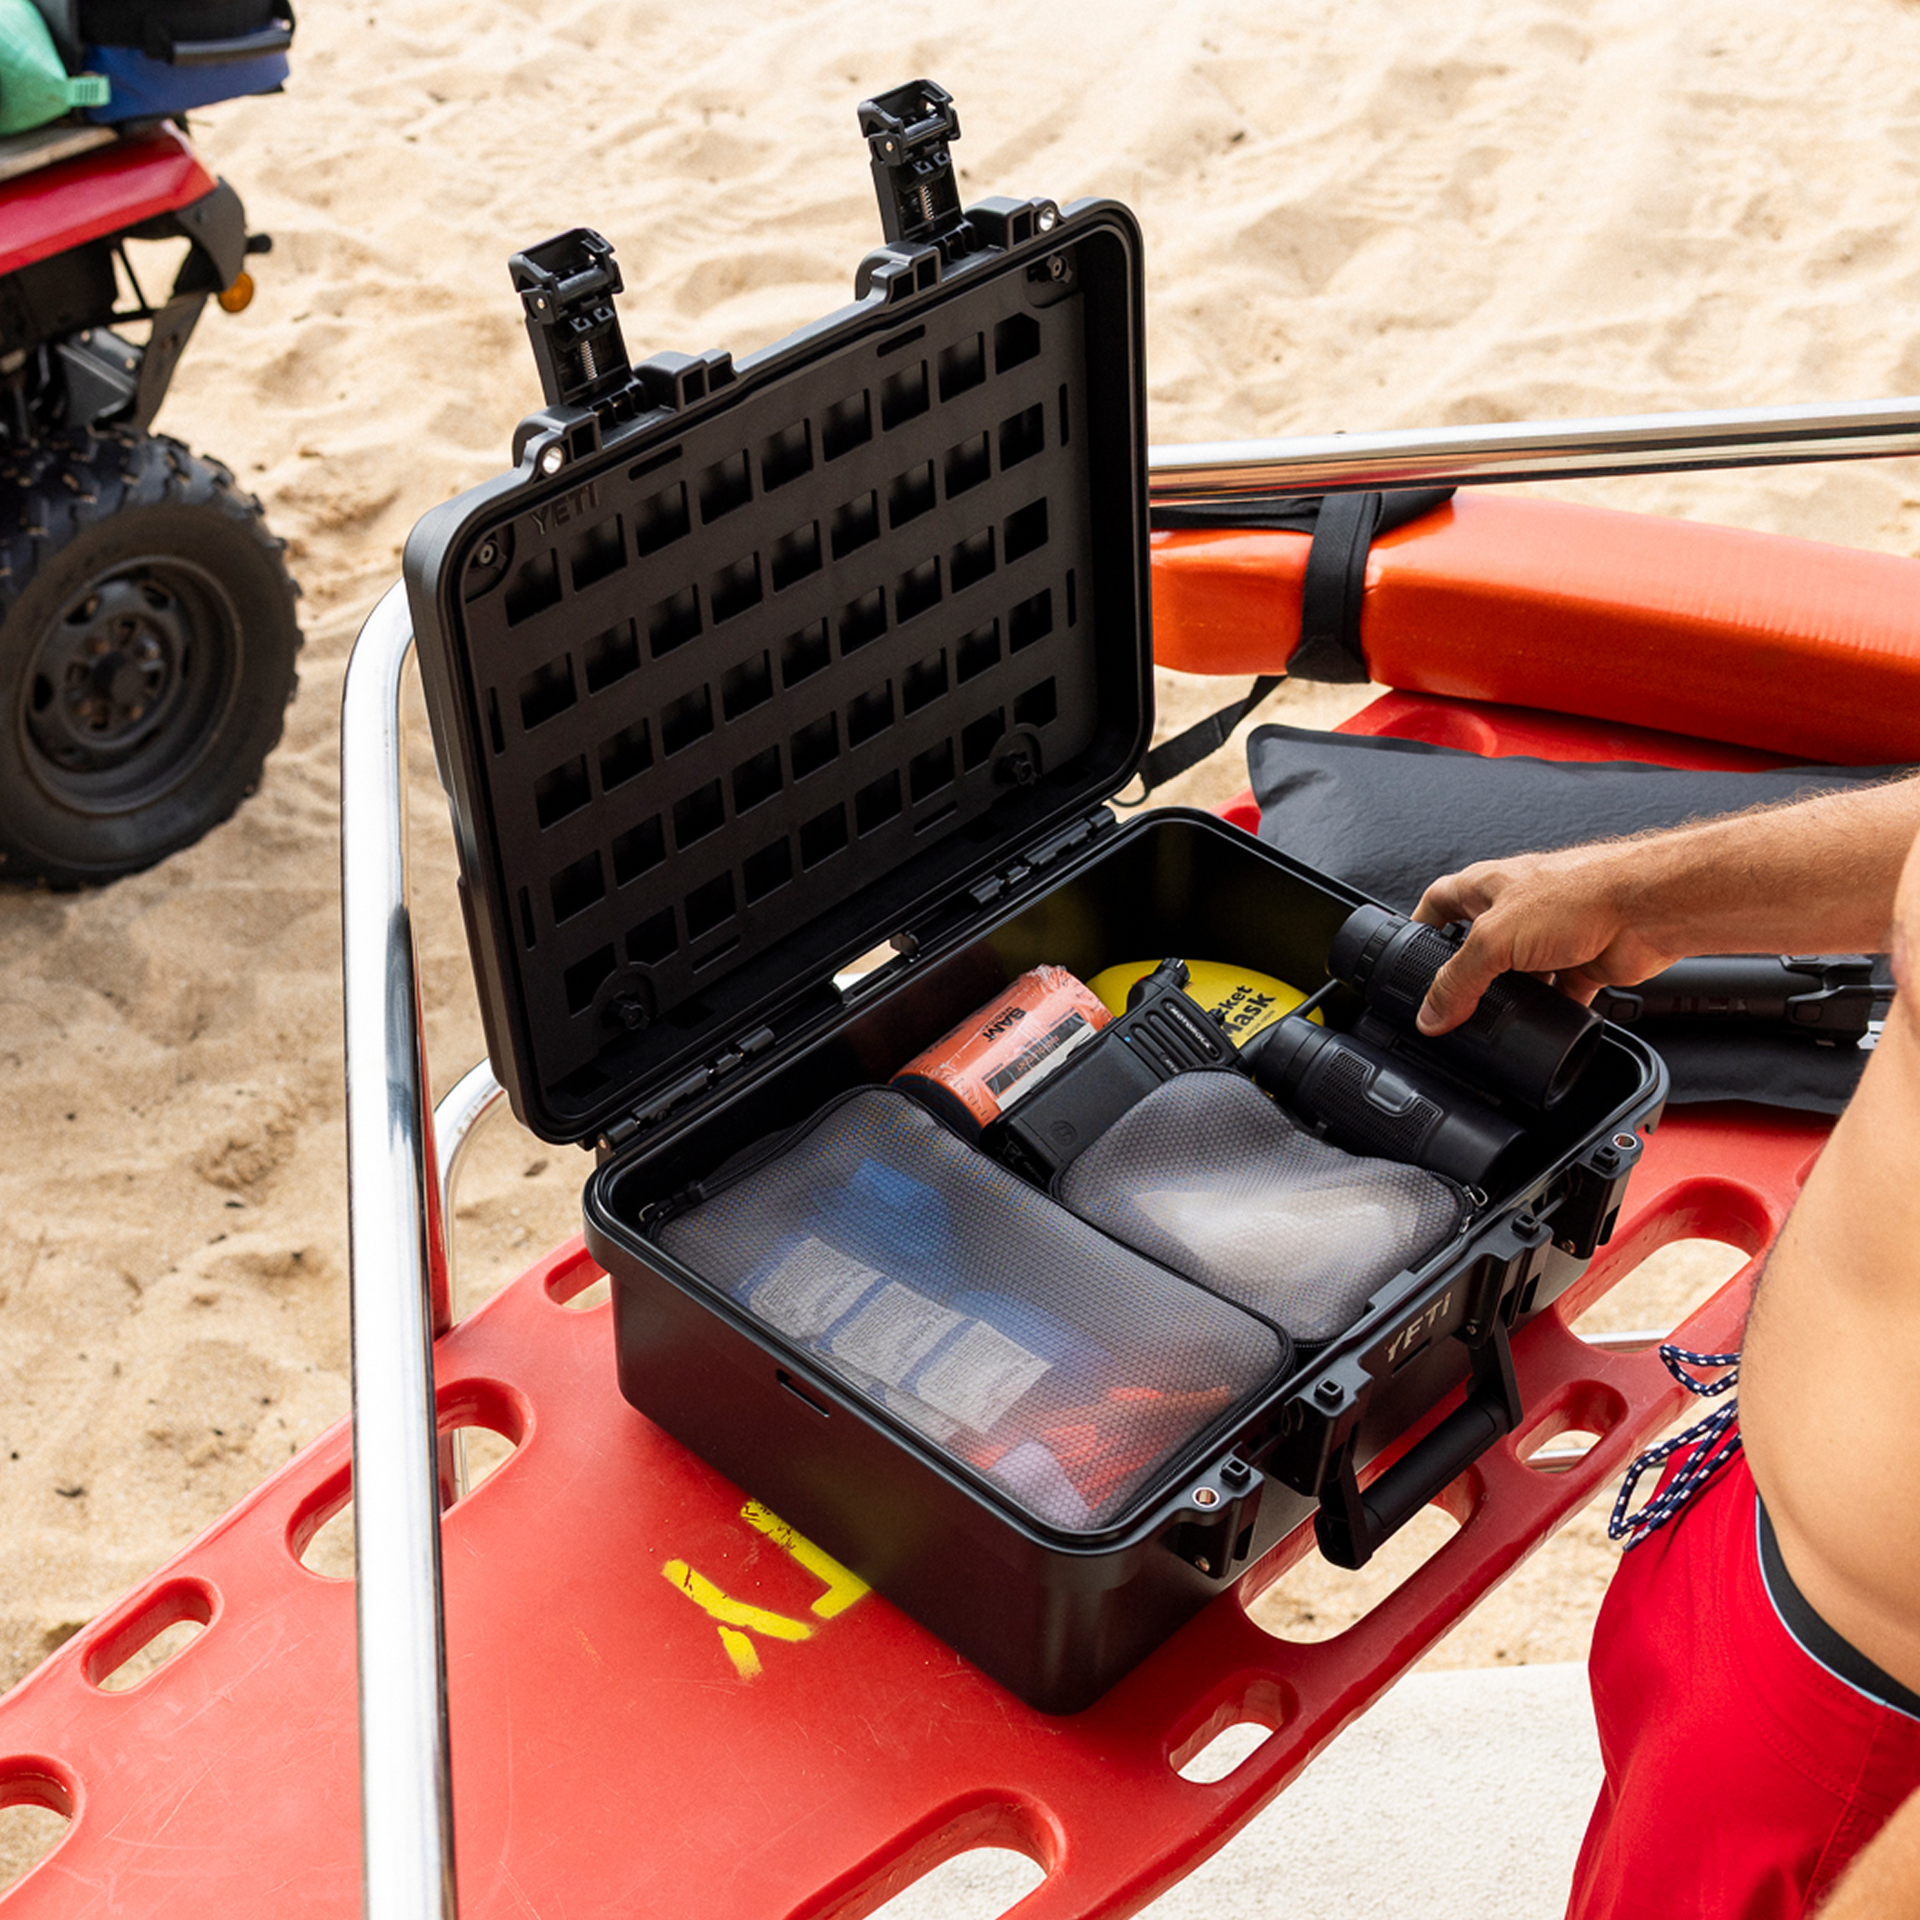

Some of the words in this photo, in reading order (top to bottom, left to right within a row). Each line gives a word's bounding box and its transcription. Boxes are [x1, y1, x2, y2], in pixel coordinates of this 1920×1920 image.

[530, 482, 599, 535] YETI
[1222, 984, 1254, 1016] ket
[1222, 993, 1277, 1040] Mask
[982, 1007, 1027, 1043] SAM
[1170, 1007, 1211, 1049] MOTOROLA
[1384, 1292, 1452, 1362] YETI
